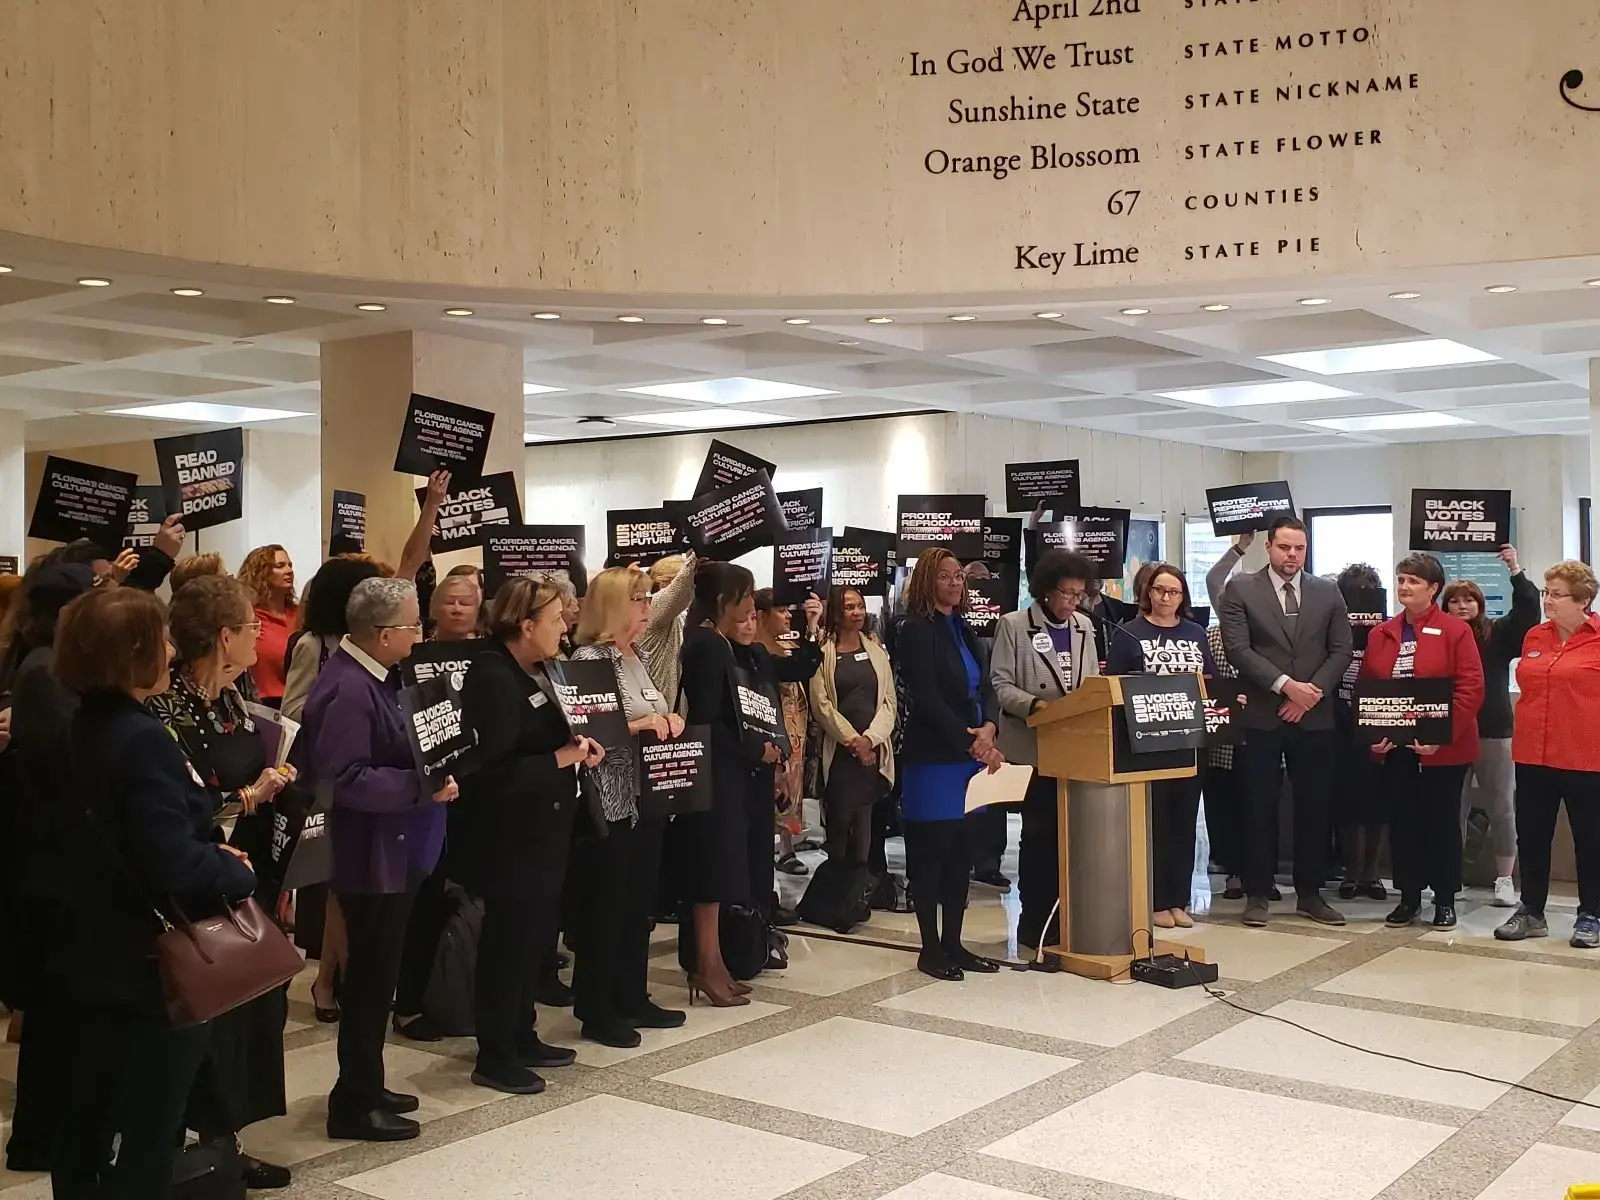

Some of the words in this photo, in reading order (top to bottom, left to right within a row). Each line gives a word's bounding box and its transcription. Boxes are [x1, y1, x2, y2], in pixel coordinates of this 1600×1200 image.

[1012, 0, 1079, 28] April
[1185, 39, 1259, 59] STATE
[1276, 28, 1369, 51] MOTTO
[910, 52, 937, 76] In
[947, 46, 1004, 75] God
[1015, 46, 1056, 71] We
[1065, 42, 1134, 68] Trust
[1185, 89, 1260, 110] STATE
[1277, 74, 1419, 101] NICKNAME
[948, 96, 1067, 124] Sunshine
[1075, 92, 1140, 117] State
[1185, 141, 1260, 160] STATE
[1278, 130, 1382, 153] FLOWER
[924, 149, 1021, 180] Orange
[1031, 143, 1141, 170] Blossom
[1107, 190, 1141, 216] 67
[1185, 187, 1319, 210] COUNTIES
[1014, 245, 1065, 275] Key
[1073, 242, 1139, 267] Lime
[1185, 242, 1259, 261] STATE
[1278, 238, 1320, 254] PIE
[414, 409, 456, 424] FLORIDA'S
[456, 419, 485, 431] CANCEL
[414, 417, 452, 431] CULTURE
[452, 426, 482, 438] AGENDA
[175, 450, 217, 468] READ
[713, 452, 746, 471] FLORIDA'S
[713, 460, 743, 475] CULTURE
[178, 461, 235, 484] BANNED
[51, 480, 93, 495] CULTURE
[183, 492, 227, 515] BOOKS
[438, 498, 495, 517] VOTES
[687, 498, 731, 522] FLORIDA'S
[732, 484, 766, 502] CANCEL
[692, 507, 731, 527] CULTURE
[732, 490, 766, 510] AGENDA
[1212, 496, 1258, 507] PROTECT
[1213, 499, 1289, 512] REPRODUCTIVE
[1425, 499, 1485, 510] BLACK
[901, 512, 952, 520] PROTECT
[901, 519, 981, 527] REPRODUCTIVE
[1215, 512, 1263, 523] FREEDOM
[1425, 510, 1485, 520] VOTES
[630, 521, 670, 531] VOICES
[630, 528, 676, 539] HISTORY
[616, 524, 631, 547] OUR
[630, 535, 673, 546] FUTURE
[900, 533, 953, 541] FREEDOM
[1423, 530, 1496, 542] MATTER
[778, 542, 811, 552] FLORIDA'S
[780, 549, 810, 559] CULTURE
[1140, 637, 1201, 652] BLACK
[1144, 651, 1204, 664] VOTES
[737, 685, 751, 715] OUR
[747, 689, 771, 707] VOICES
[1145, 692, 1188, 703] VOICES
[1147, 700, 1196, 713] HISTORY
[423, 699, 453, 722] VOICES
[748, 697, 777, 717] HISTORY
[750, 707, 777, 725] FUTURE
[1132, 694, 1149, 723] OUR
[1148, 710, 1194, 722] FUTURE
[1358, 703, 1449, 711] REPRODUCTIVE
[427, 708, 462, 735] HISTORY
[1358, 718, 1416, 726] FREEDOM
[412, 710, 432, 753] OUR
[430, 722, 461, 749] FUTURE
[642, 743, 673, 754] FLORIDA'S
[674, 741, 705, 750] CANCEL
[643, 752, 672, 762] CULTURE
[672, 749, 703, 758] AGENDA
